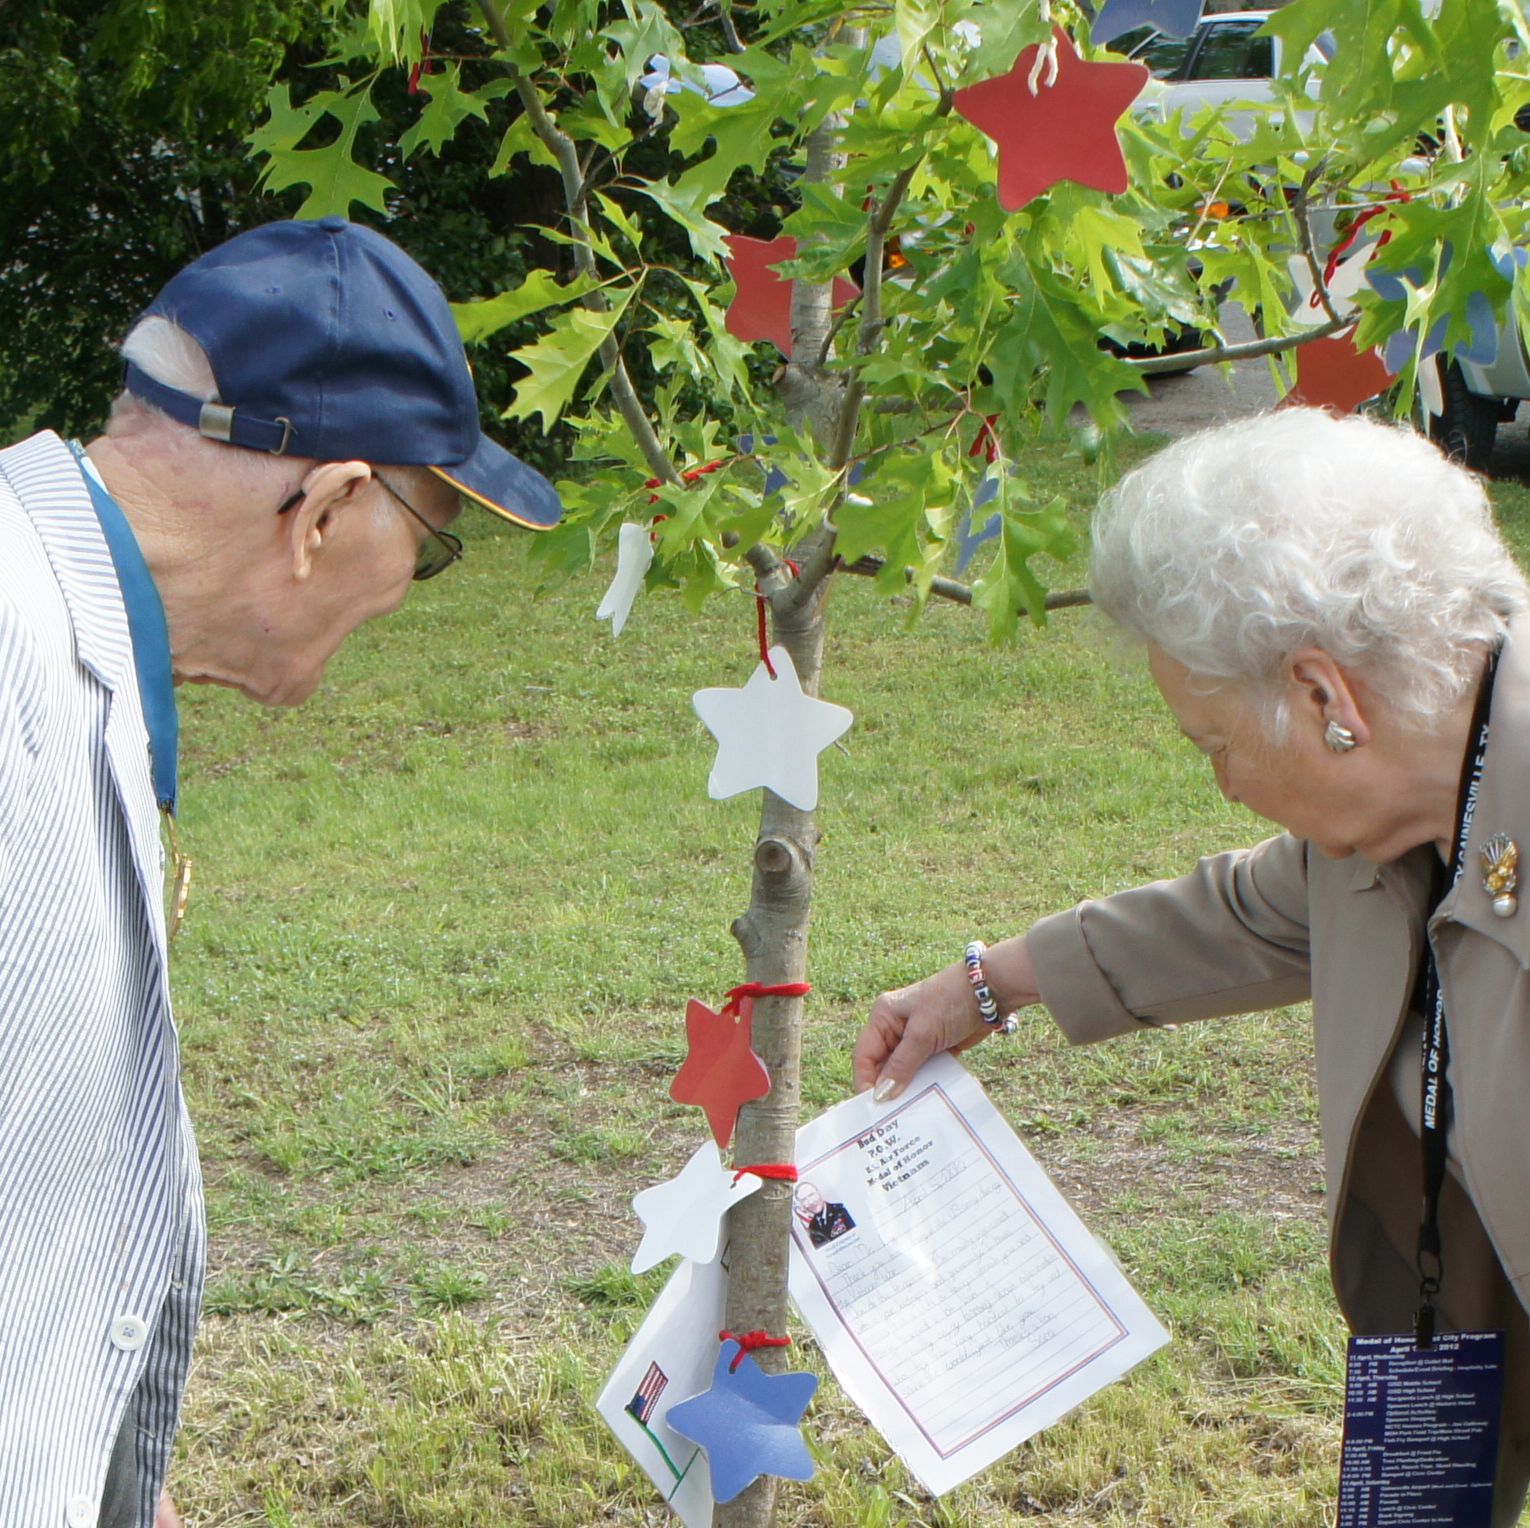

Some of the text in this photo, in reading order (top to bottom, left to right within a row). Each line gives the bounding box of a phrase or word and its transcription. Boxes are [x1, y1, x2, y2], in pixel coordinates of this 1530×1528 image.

[1428, 1047, 1439, 1074] OF
[1425, 1075, 1438, 1130] MEDAL
[857, 1118, 900, 1148] Bud Day
[893, 1135, 921, 1156] Force
[891, 1160, 902, 1170] of
[902, 1140, 934, 1163] Honor
[882, 1158, 929, 1191] Vietnam
[1389, 1345, 1409, 1353] April
[1442, 1334, 1459, 1342] City
[1460, 1332, 1496, 1341] Program
